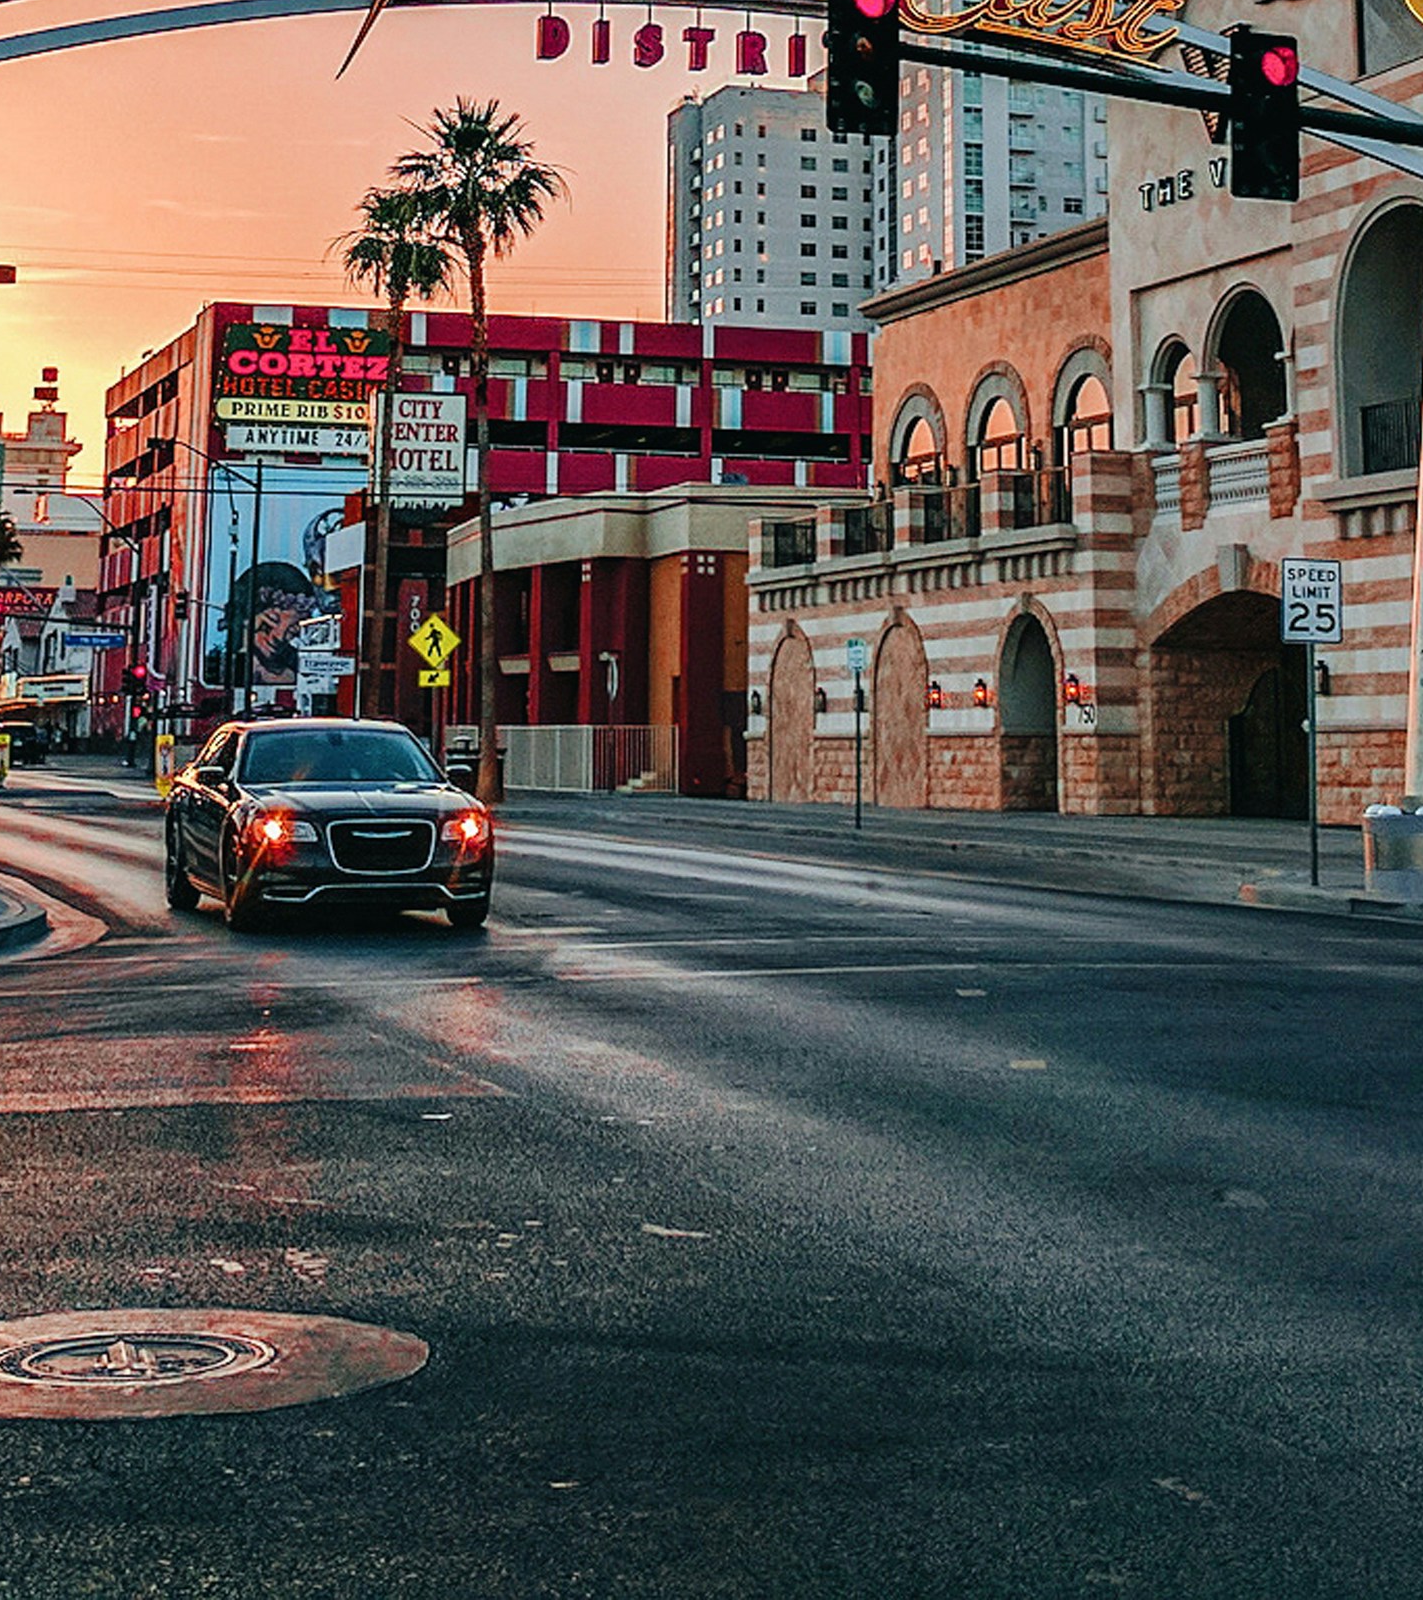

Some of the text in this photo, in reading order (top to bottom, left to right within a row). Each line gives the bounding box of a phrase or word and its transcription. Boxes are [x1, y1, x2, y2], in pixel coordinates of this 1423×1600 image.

[536, 14, 829, 78] DISTRI
[1138, 168, 1195, 212] THE
[288, 329, 337, 353] EL
[228, 349, 390, 381] CORTEZ
[232, 401, 289, 417] PRIME
[297, 404, 328, 419] RIB
[398, 400, 443, 419] CITY
[245, 429, 319, 447] ANYTIME
[393, 422, 458, 442] ENTER
[1287, 568, 1337, 582] SPEED
[1292, 586, 1331, 599] LIMIT
[1289, 601, 1336, 633] 25
